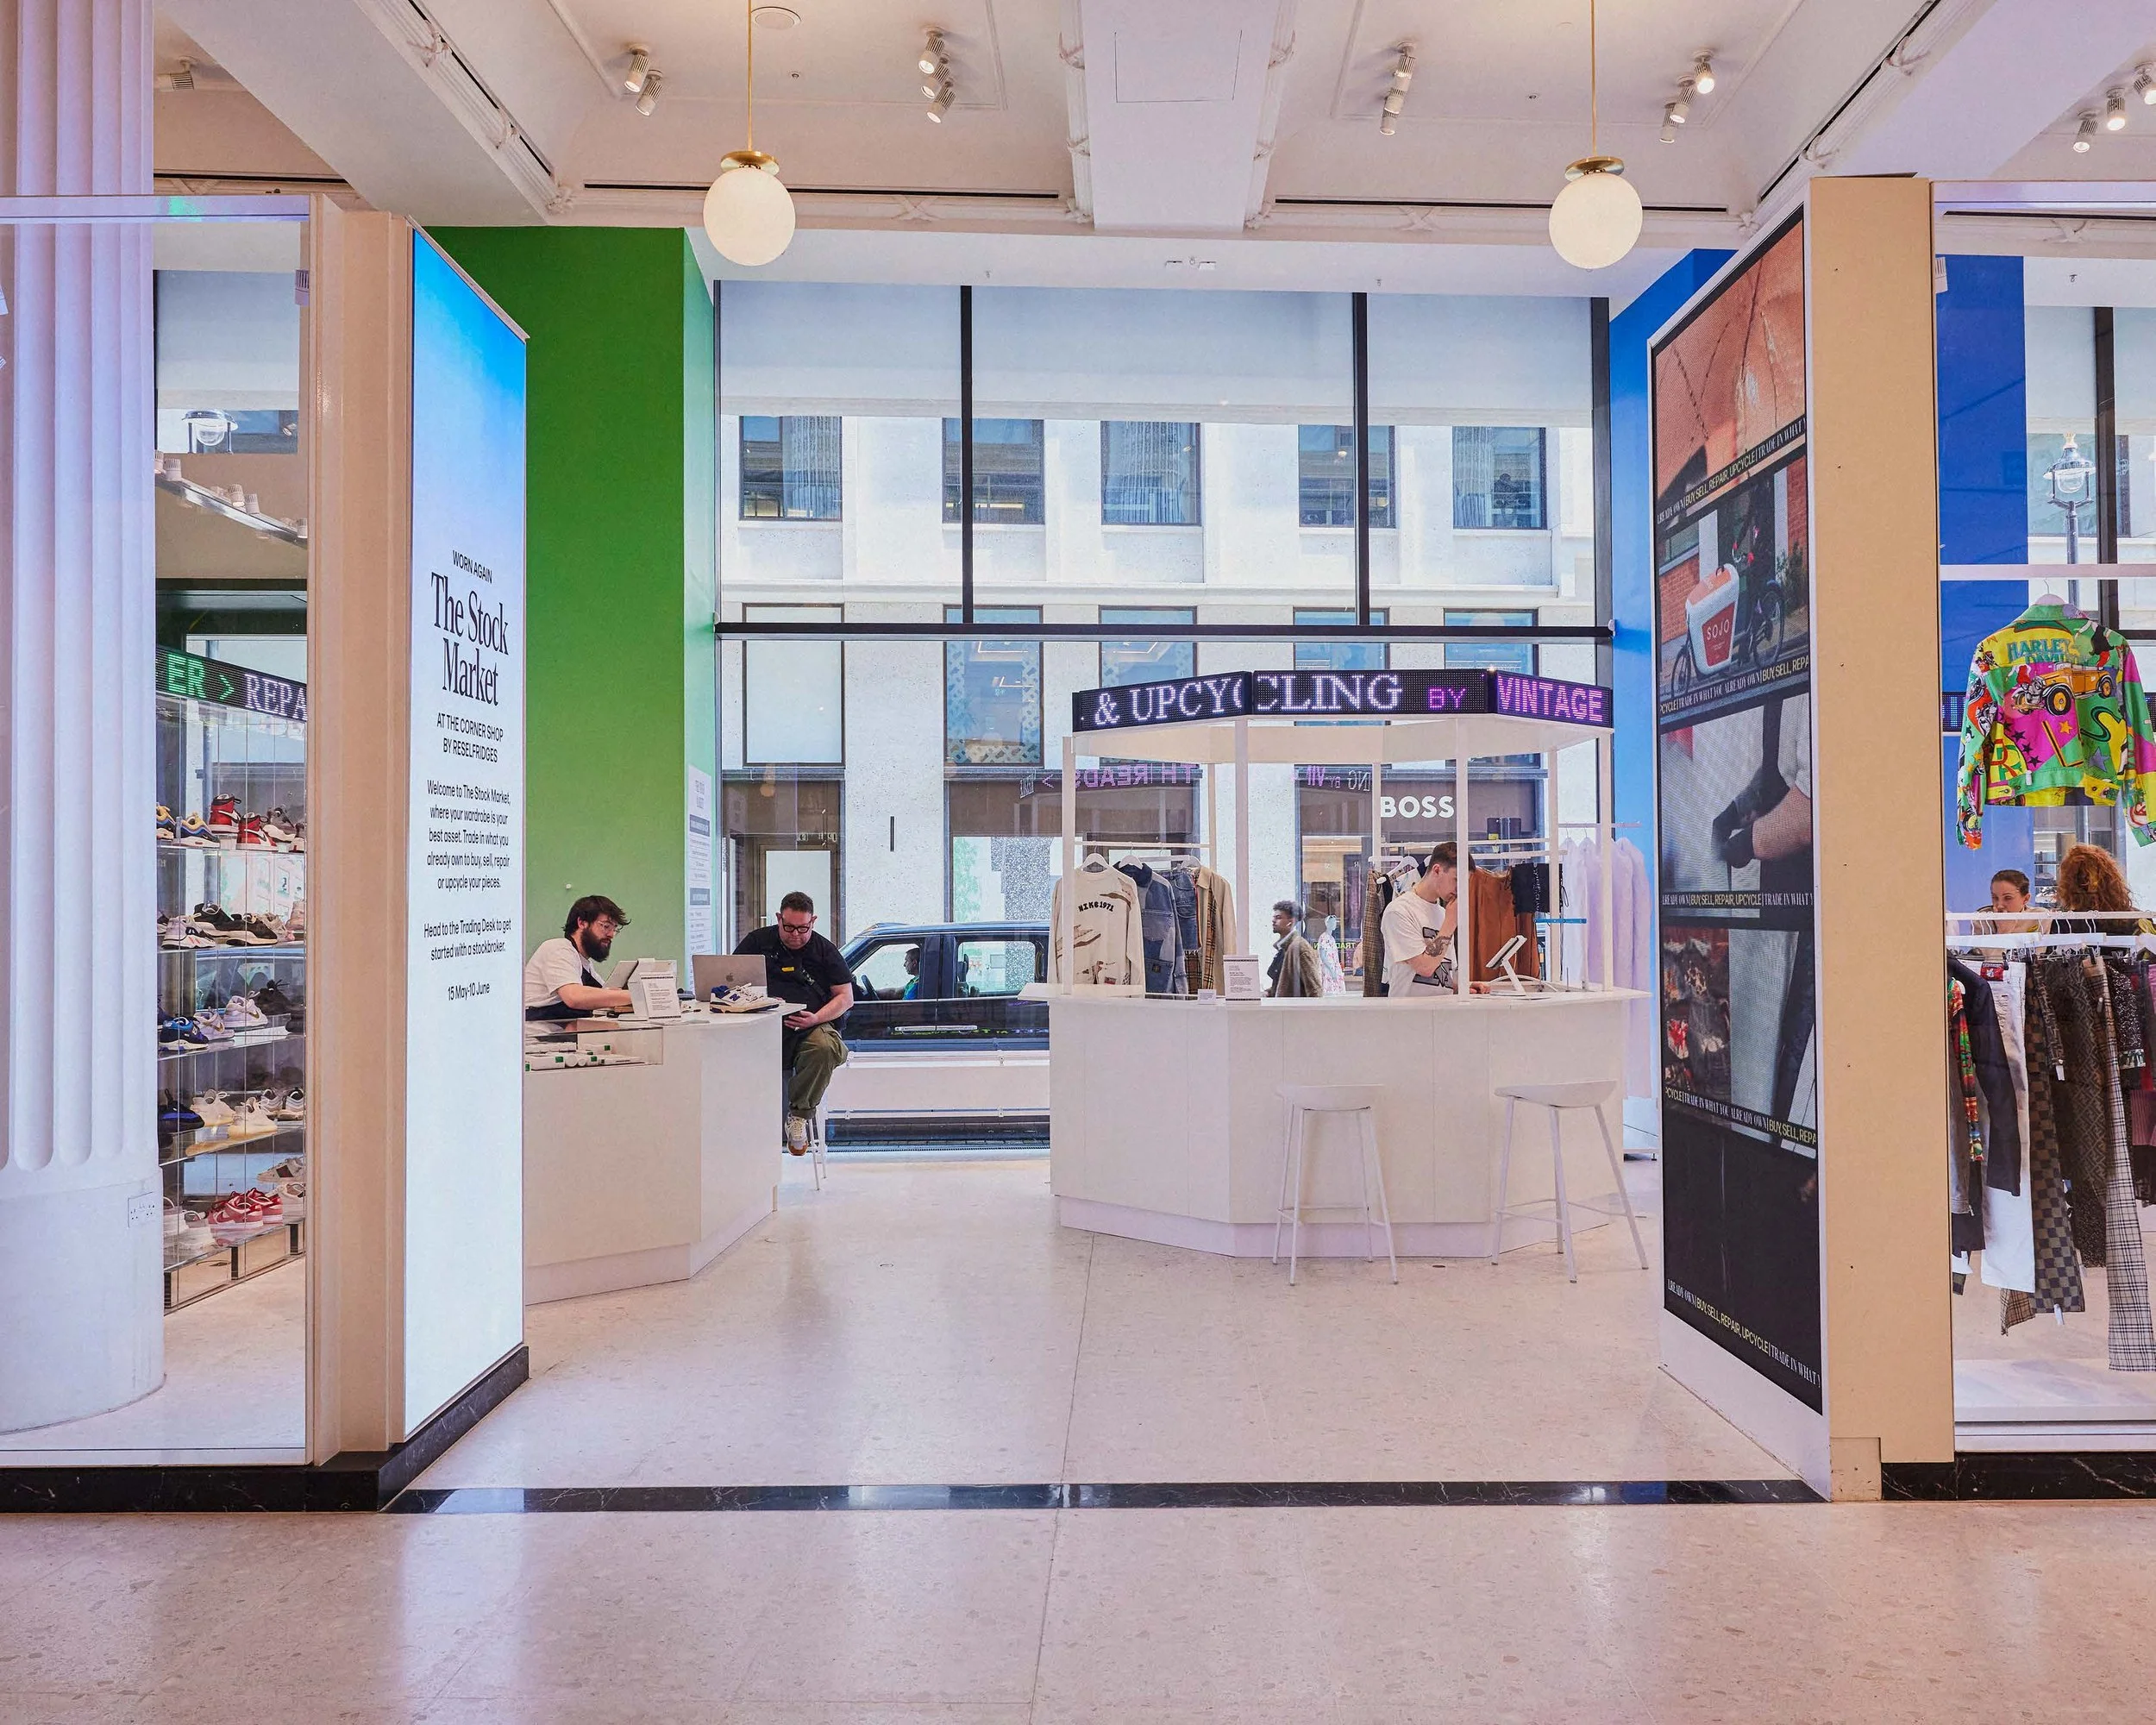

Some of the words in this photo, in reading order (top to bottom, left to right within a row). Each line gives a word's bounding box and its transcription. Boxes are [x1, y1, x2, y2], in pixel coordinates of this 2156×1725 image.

[452, 549, 473, 574] WORN
[473, 561, 492, 584] AGAIN
[430, 572, 464, 637] The
[467, 590, 509, 656] Stock
[1707, 619, 1730, 641] SOJO
[442, 637, 498, 706] Market
[1094, 693, 1120, 724] &
[1427, 687, 1466, 710] BY
[1496, 674, 1604, 722] VINTAGE
[436, 712, 446, 728] AT
[446, 714, 460, 731] THE
[460, 718, 486, 738] CORNER
[486, 725, 504, 742] SHOP
[442, 737, 452, 753] BY
[453, 740, 498, 762] RESELFRIDGES
[427, 780, 455, 796] Welcome
[456, 785, 462, 798] to
[463, 785, 474, 800] The
[474, 786, 491, 801] Stock
[491, 789, 511, 806] Market,
[429, 804, 449, 819] where
[450, 809, 463, 823] your
[464, 808, 491, 823] wardrobe
[491, 811, 496, 824] is
[496, 814, 508, 826] your
[1380, 796, 1455, 819] BOSS
[429, 827, 443, 842] best
[443, 830, 461, 843] asset.
[463, 830, 479, 844] Trade
[479, 831, 485, 844] in
[486, 831, 499, 845] what
[499, 836, 509, 848] you
[427, 851, 450, 869] already
[451, 855, 463, 866] own
[464, 853, 470, 866] to
[471, 852, 482, 869] buy,
[482, 853, 494, 868] sell,
[494, 854, 510, 869] repair
[437, 877, 444, 889] or
[445, 874, 467, 892] upcycle
[468, 877, 481, 891] your
[481, 875, 501, 891] pieces.
[1099, 901, 1114, 913] 1971
[1735, 894, 1761, 906] UPCYCLE
[1764, 893, 1783, 905] TRADE
[1783, 893, 1790, 905] IN
[423, 921, 441, 938] Head
[442, 922, 448, 936] to
[449, 921, 459, 935] the
[460, 919, 481, 935] Trading
[481, 918, 495, 932] Desk
[496, 919, 502, 931] to
[502, 918, 511, 934] get
[430, 944, 454, 961] started
[454, 942, 467, 957] with
[467, 944, 472, 956] a
[472, 939, 505, 955] stockbroker.
[448, 986, 454, 1000] 15
[476, 982, 490, 995] June
[1782, 1123, 1799, 1141] SELL,
[1720, 1313, 1742, 1338] REPAIR,
[1742, 1326, 1769, 1354] UPCYCLE
[1771, 1345, 1790, 1369] TRADE
[1790, 1357, 1797, 1373] IN
[1797, 1362, 1816, 1385] WHAT
